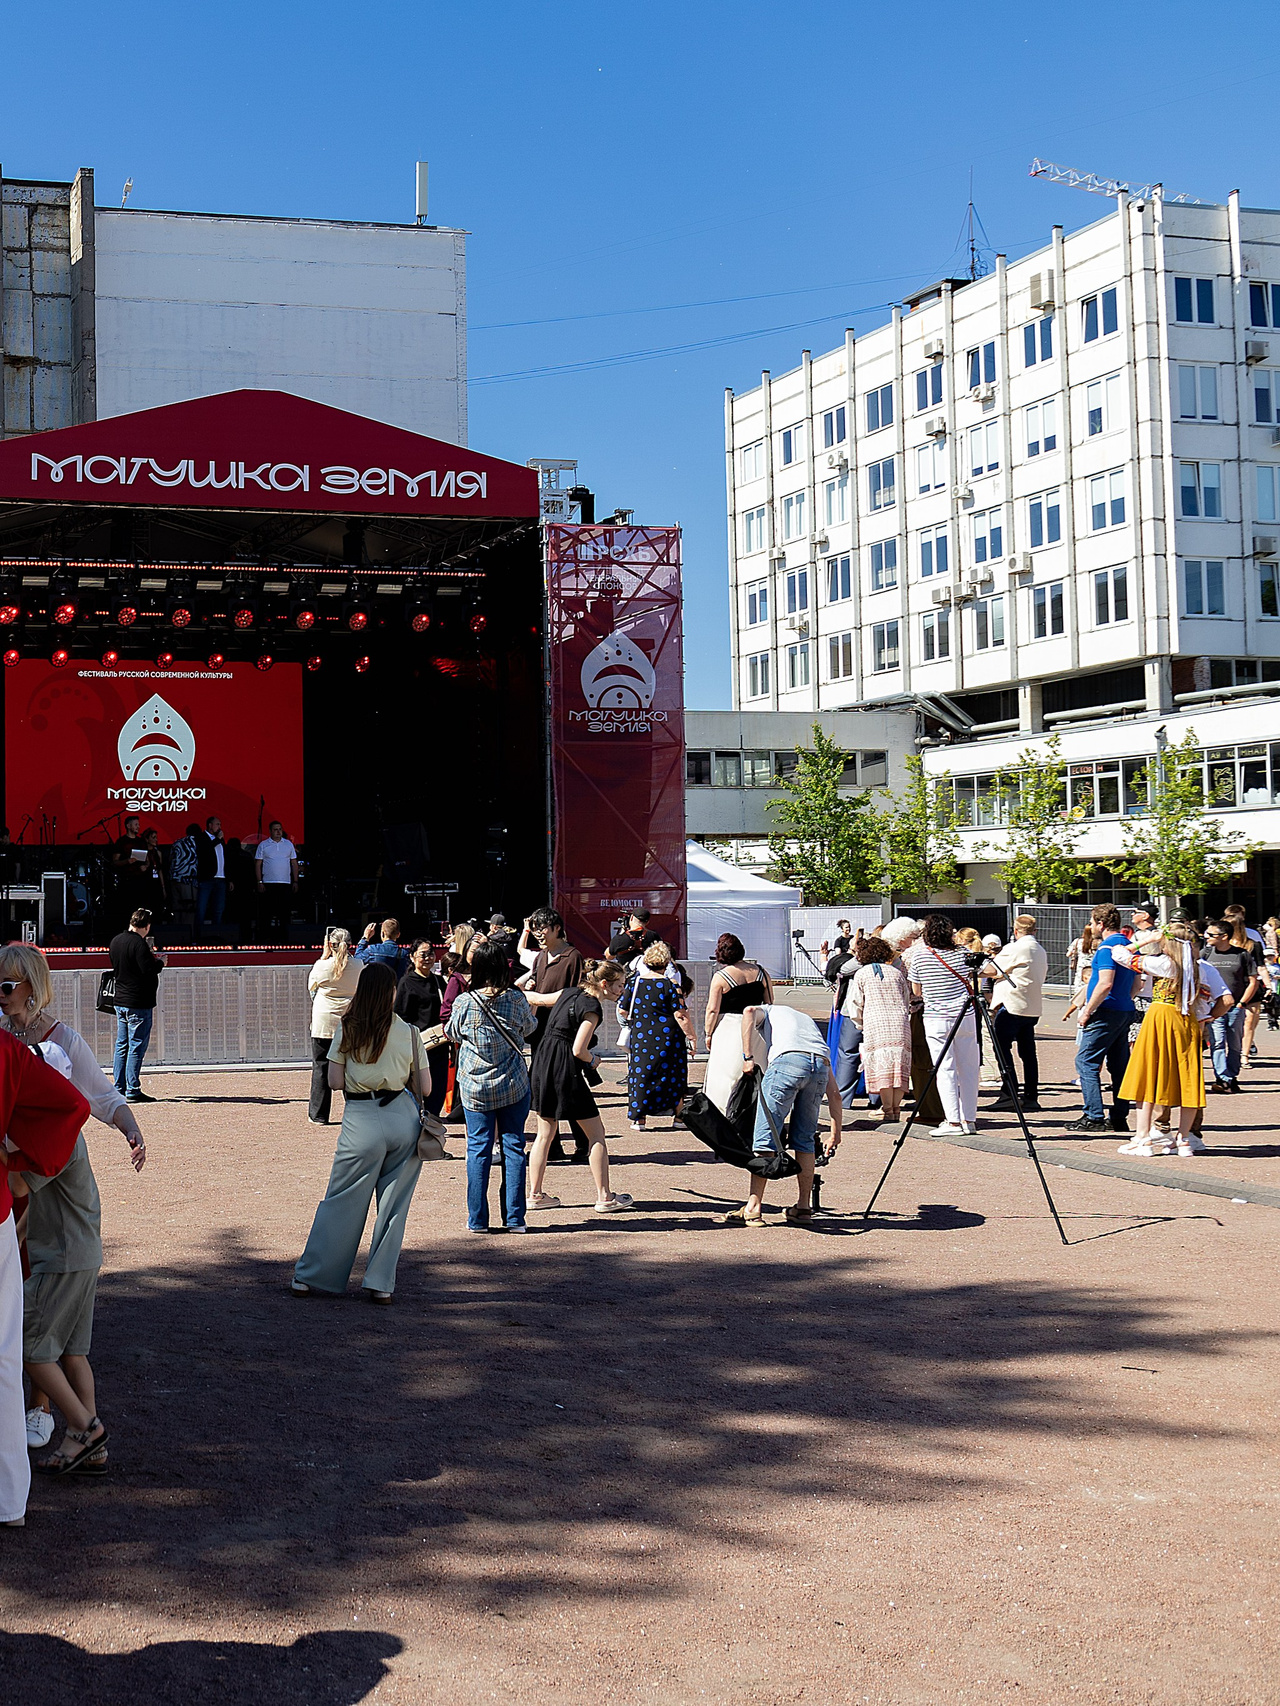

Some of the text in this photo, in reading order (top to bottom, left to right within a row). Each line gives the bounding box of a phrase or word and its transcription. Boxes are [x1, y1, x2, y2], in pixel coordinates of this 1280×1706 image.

[77, 669, 233, 679] ФЕСТИВАЛЬ РУССКОЙ СОВРЕМЕННОЙ КУЛЬТУРЫ
[600, 899, 643, 907] ВЕДОМОСТИ
